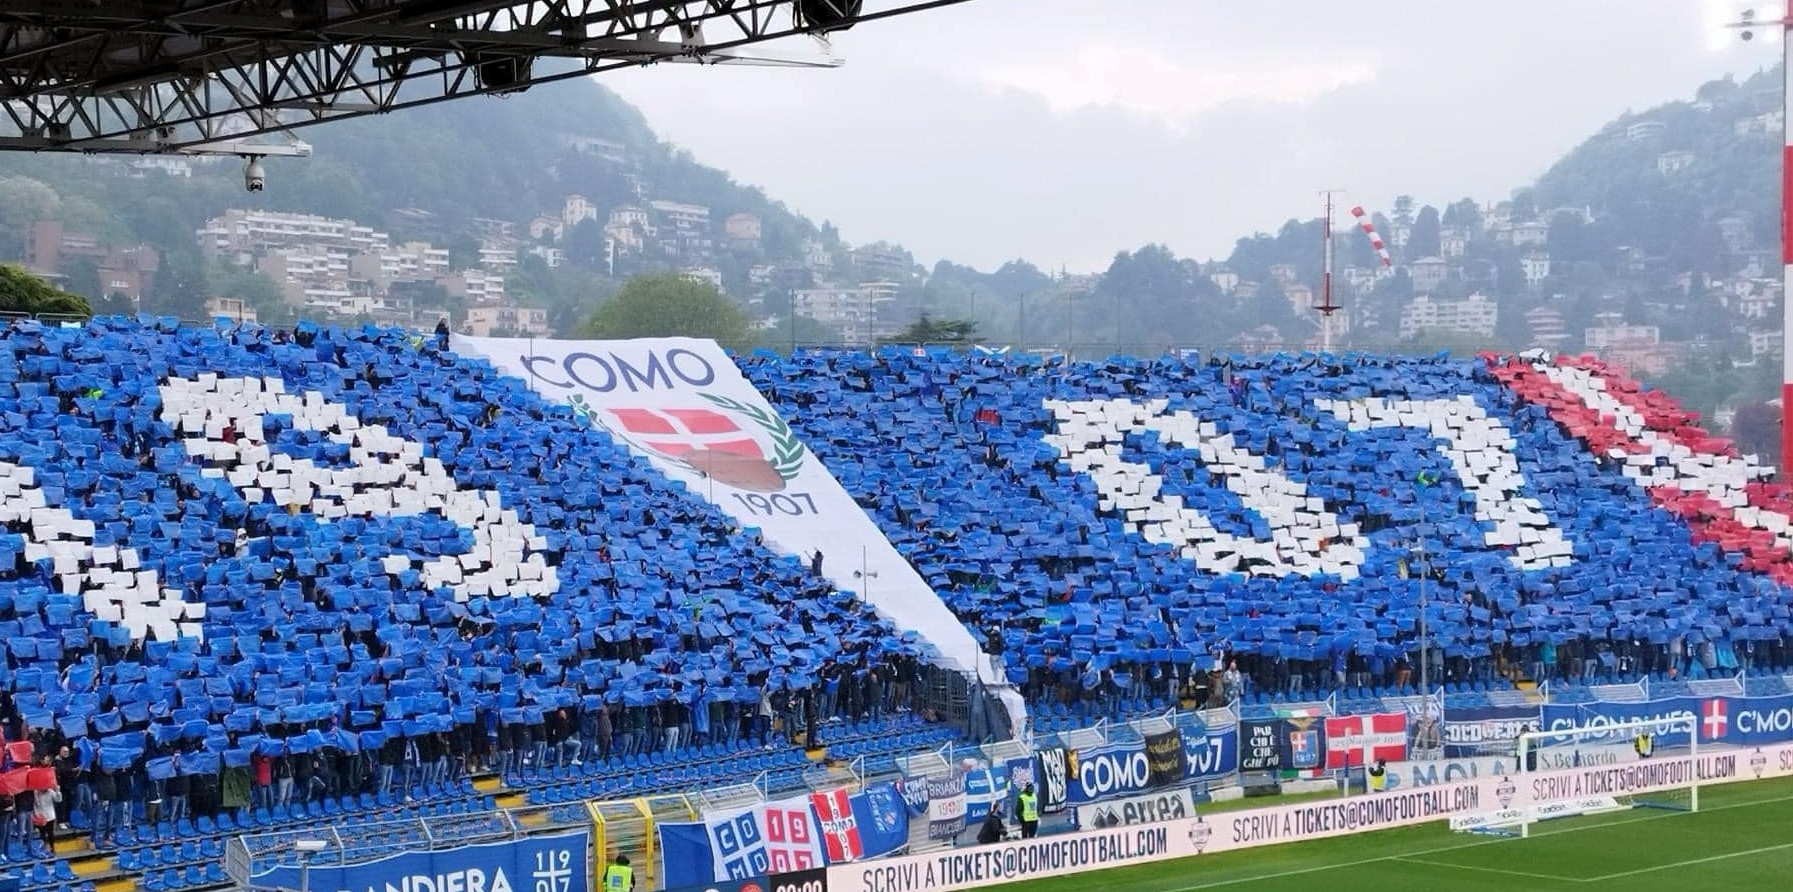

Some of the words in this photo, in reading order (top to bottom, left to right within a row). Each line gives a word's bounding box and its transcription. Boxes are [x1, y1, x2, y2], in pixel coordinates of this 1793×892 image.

[520, 348, 715, 393] COMO
[733, 492, 819, 516] 1907
[1736, 708, 1793, 734] C'MO
[1081, 752, 1149, 797] COMO
[1533, 776, 1570, 800] SCRIVI
[1574, 774, 1582, 796] A
[1584, 755, 1736, 794] TICKETS@COMOFOOTALL.COM
[1233, 814, 1278, 842] SCRIVI
[1282, 812, 1293, 835] A
[1294, 785, 1479, 832] TICKETS@COMOFOOTBALL.COM
[863, 866, 919, 892] SCRIVI
[924, 867, 936, 887] A
[939, 827, 1167, 885] TICKETS@COMOFOOTBALL.COM
